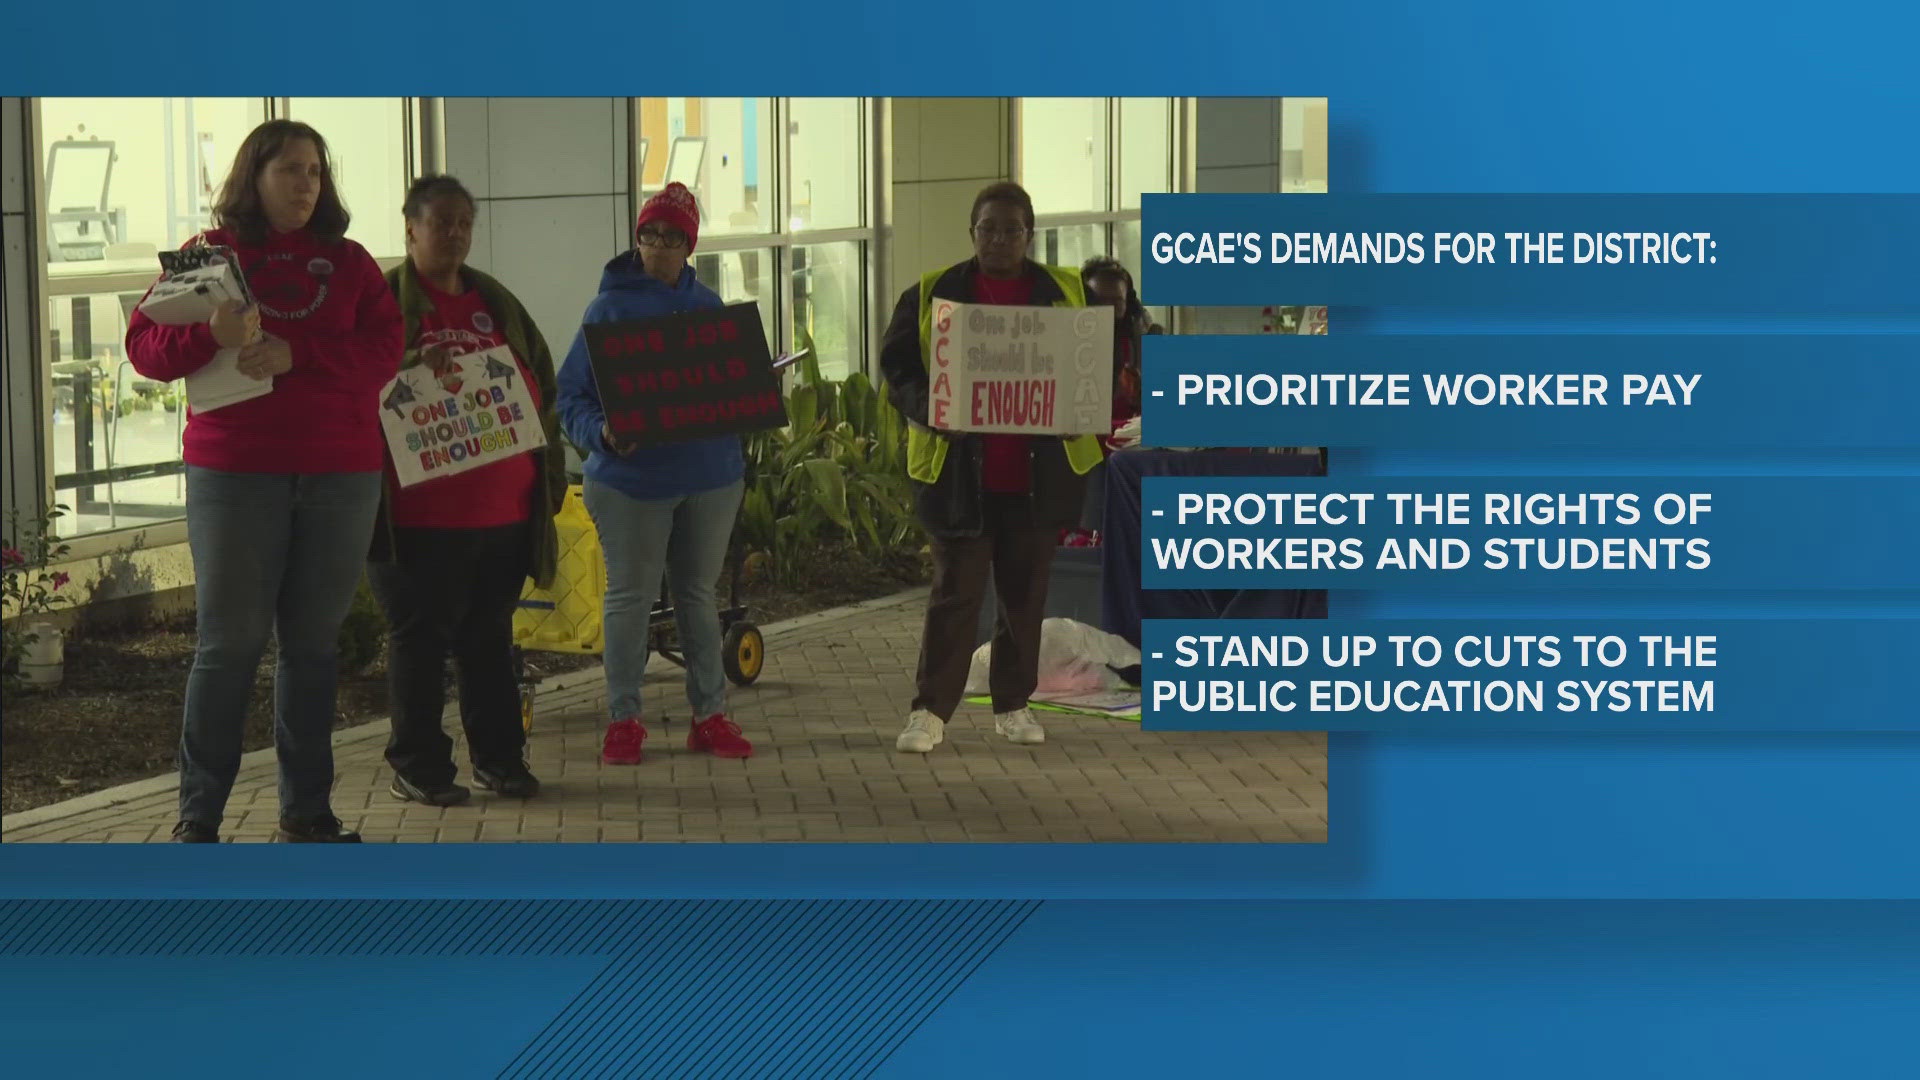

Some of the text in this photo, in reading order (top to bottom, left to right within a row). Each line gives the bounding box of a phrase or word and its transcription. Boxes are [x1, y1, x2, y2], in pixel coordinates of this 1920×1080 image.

[604, 319, 740, 359] ONE JOB
[968, 308, 1046, 339] One job
[616, 357, 748, 396] SHOULD
[932, 303, 952, 428] GCAE
[1031, 343, 1054, 374] be
[412, 385, 505, 426] ONE JOB
[658, 391, 780, 430] ENOUGH
[971, 379, 1056, 428] ENOUGH
[405, 402, 524, 452] SHOULD BE
[419, 426, 519, 472] ENOUGH!
